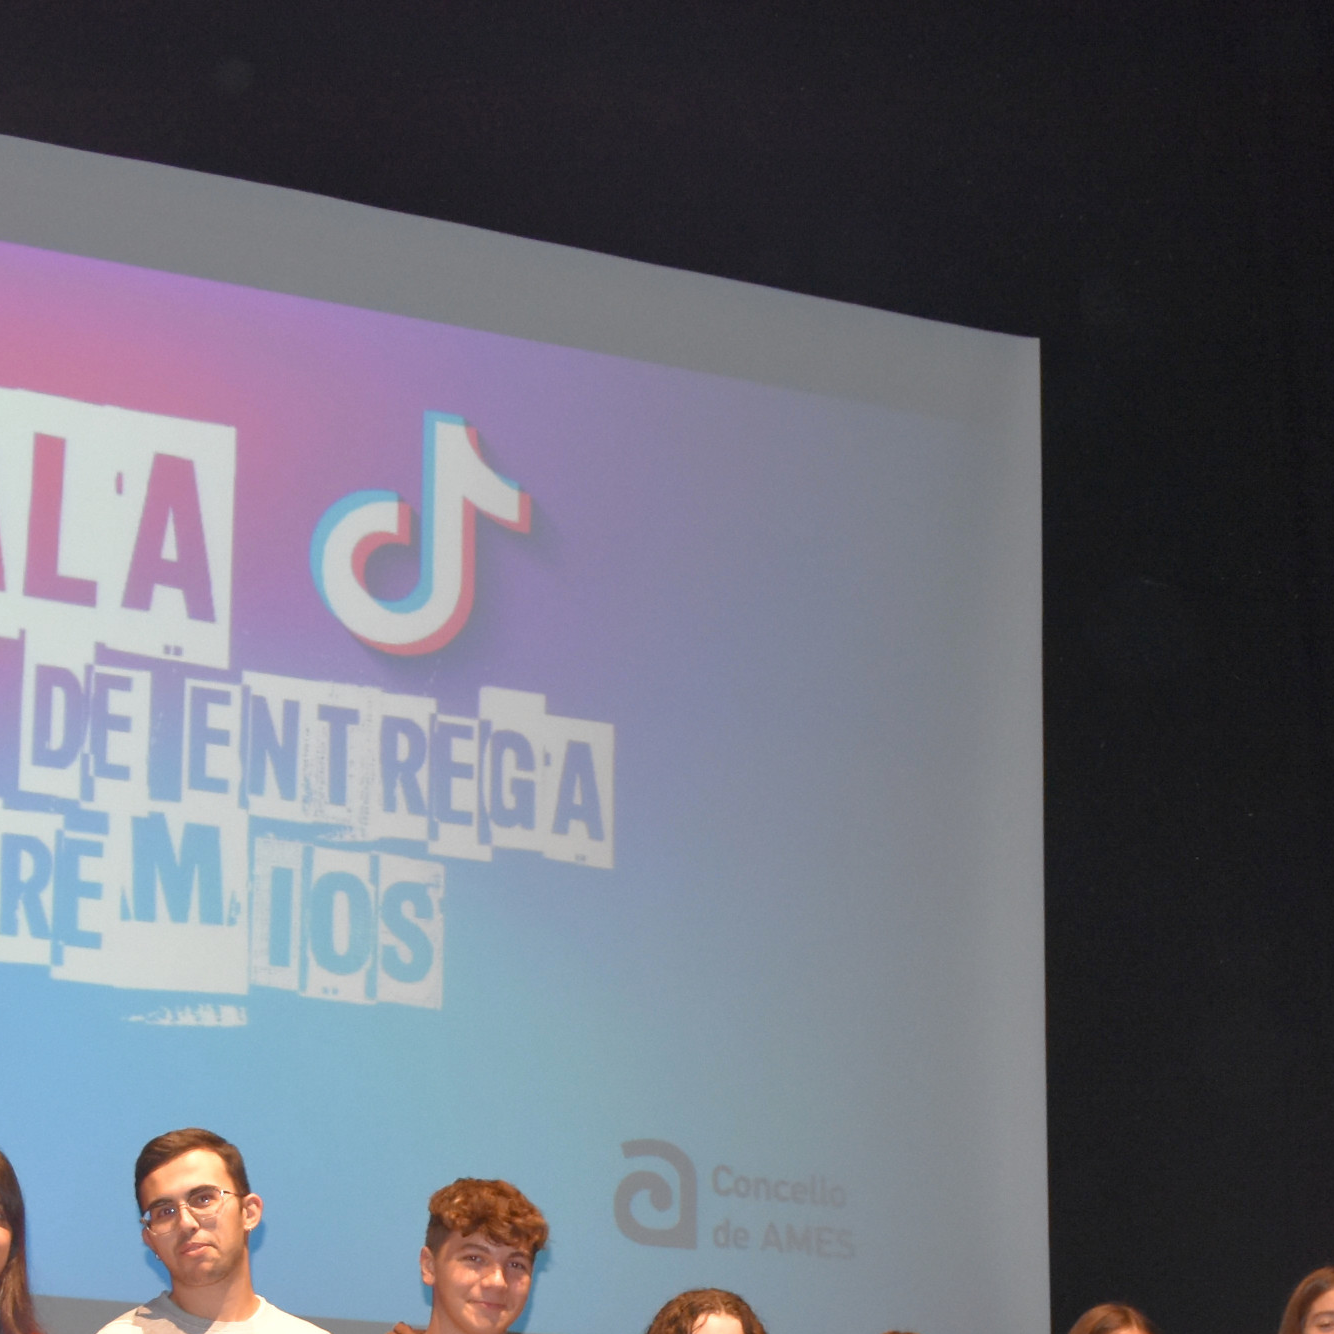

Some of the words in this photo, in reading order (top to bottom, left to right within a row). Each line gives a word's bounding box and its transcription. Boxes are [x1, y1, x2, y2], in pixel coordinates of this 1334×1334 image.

[30, 663, 134, 782] DE
[188, 685, 605, 843] ENTREGA
[712, 1164, 848, 1209] Concello
[712, 1219, 751, 1249] de
[761, 1221, 856, 1260] AMES
